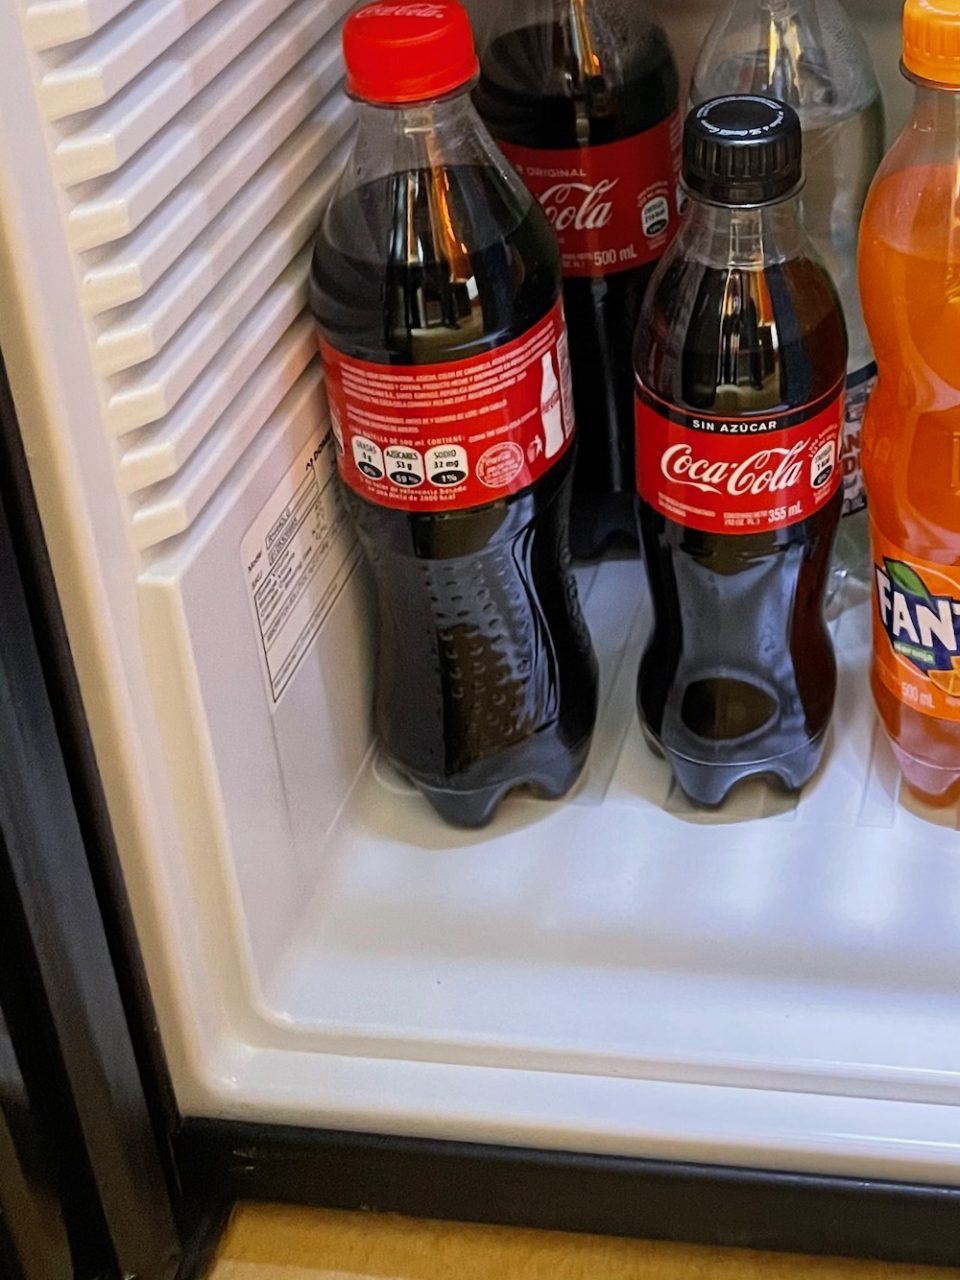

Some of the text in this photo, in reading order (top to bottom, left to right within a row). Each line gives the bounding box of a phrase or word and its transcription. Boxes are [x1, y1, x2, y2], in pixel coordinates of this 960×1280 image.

[527, 166, 587, 178] ORIGINAL
[594, 248, 617, 267] 500
[692, 419, 778, 434] SIN AZÚCAR
[434, 450, 456, 460] SODIO
[660, 436, 811, 496] Coca-Cola
[768, 505, 786, 523] 355
